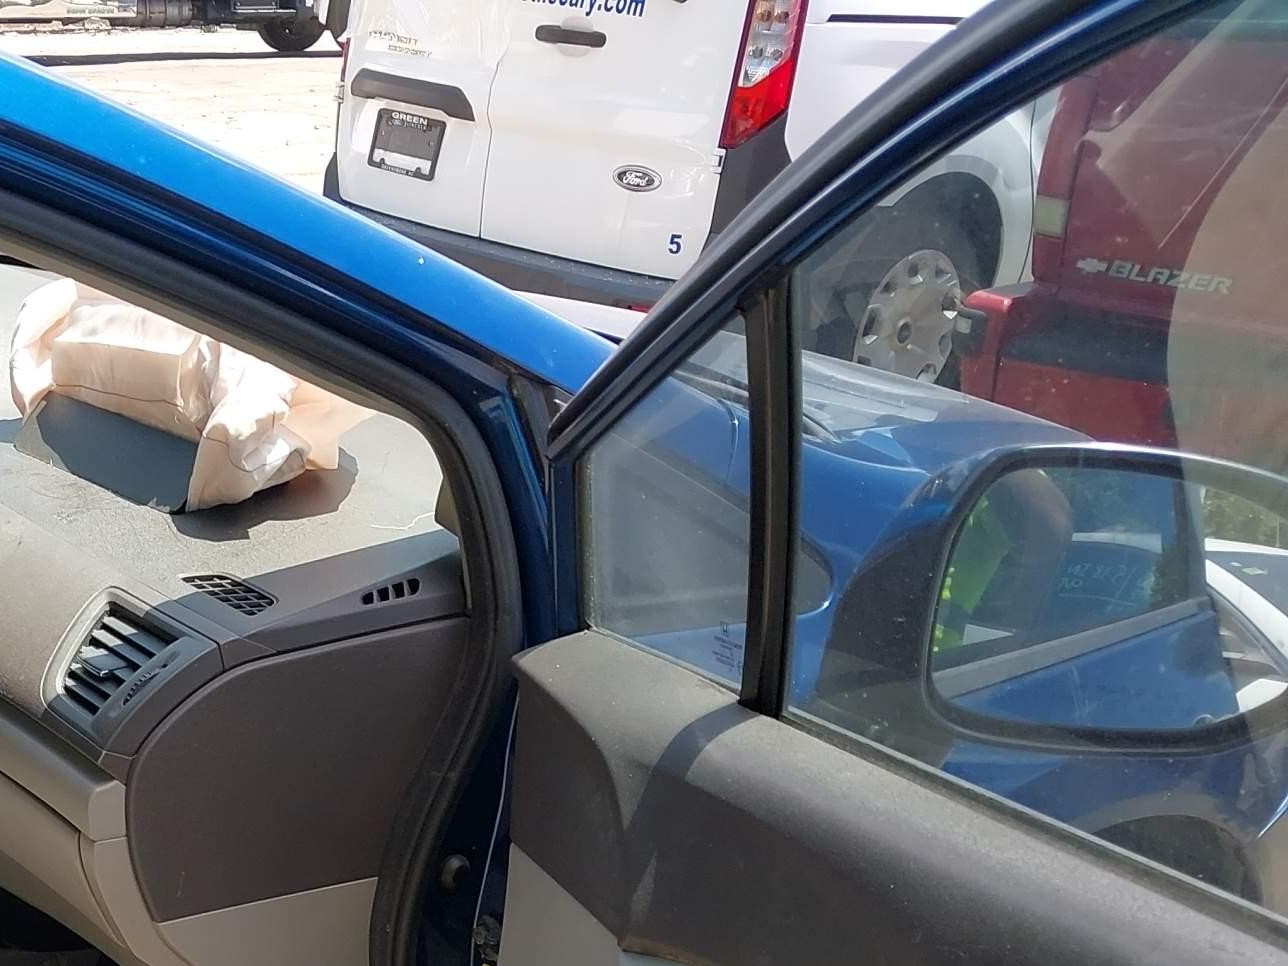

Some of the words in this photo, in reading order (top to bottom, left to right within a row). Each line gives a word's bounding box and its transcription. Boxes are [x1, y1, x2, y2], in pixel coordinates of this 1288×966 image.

[391, 112, 428, 126] GREEN
[668, 234, 683, 255] 5
[1109, 259, 1233, 295] BLAZER
